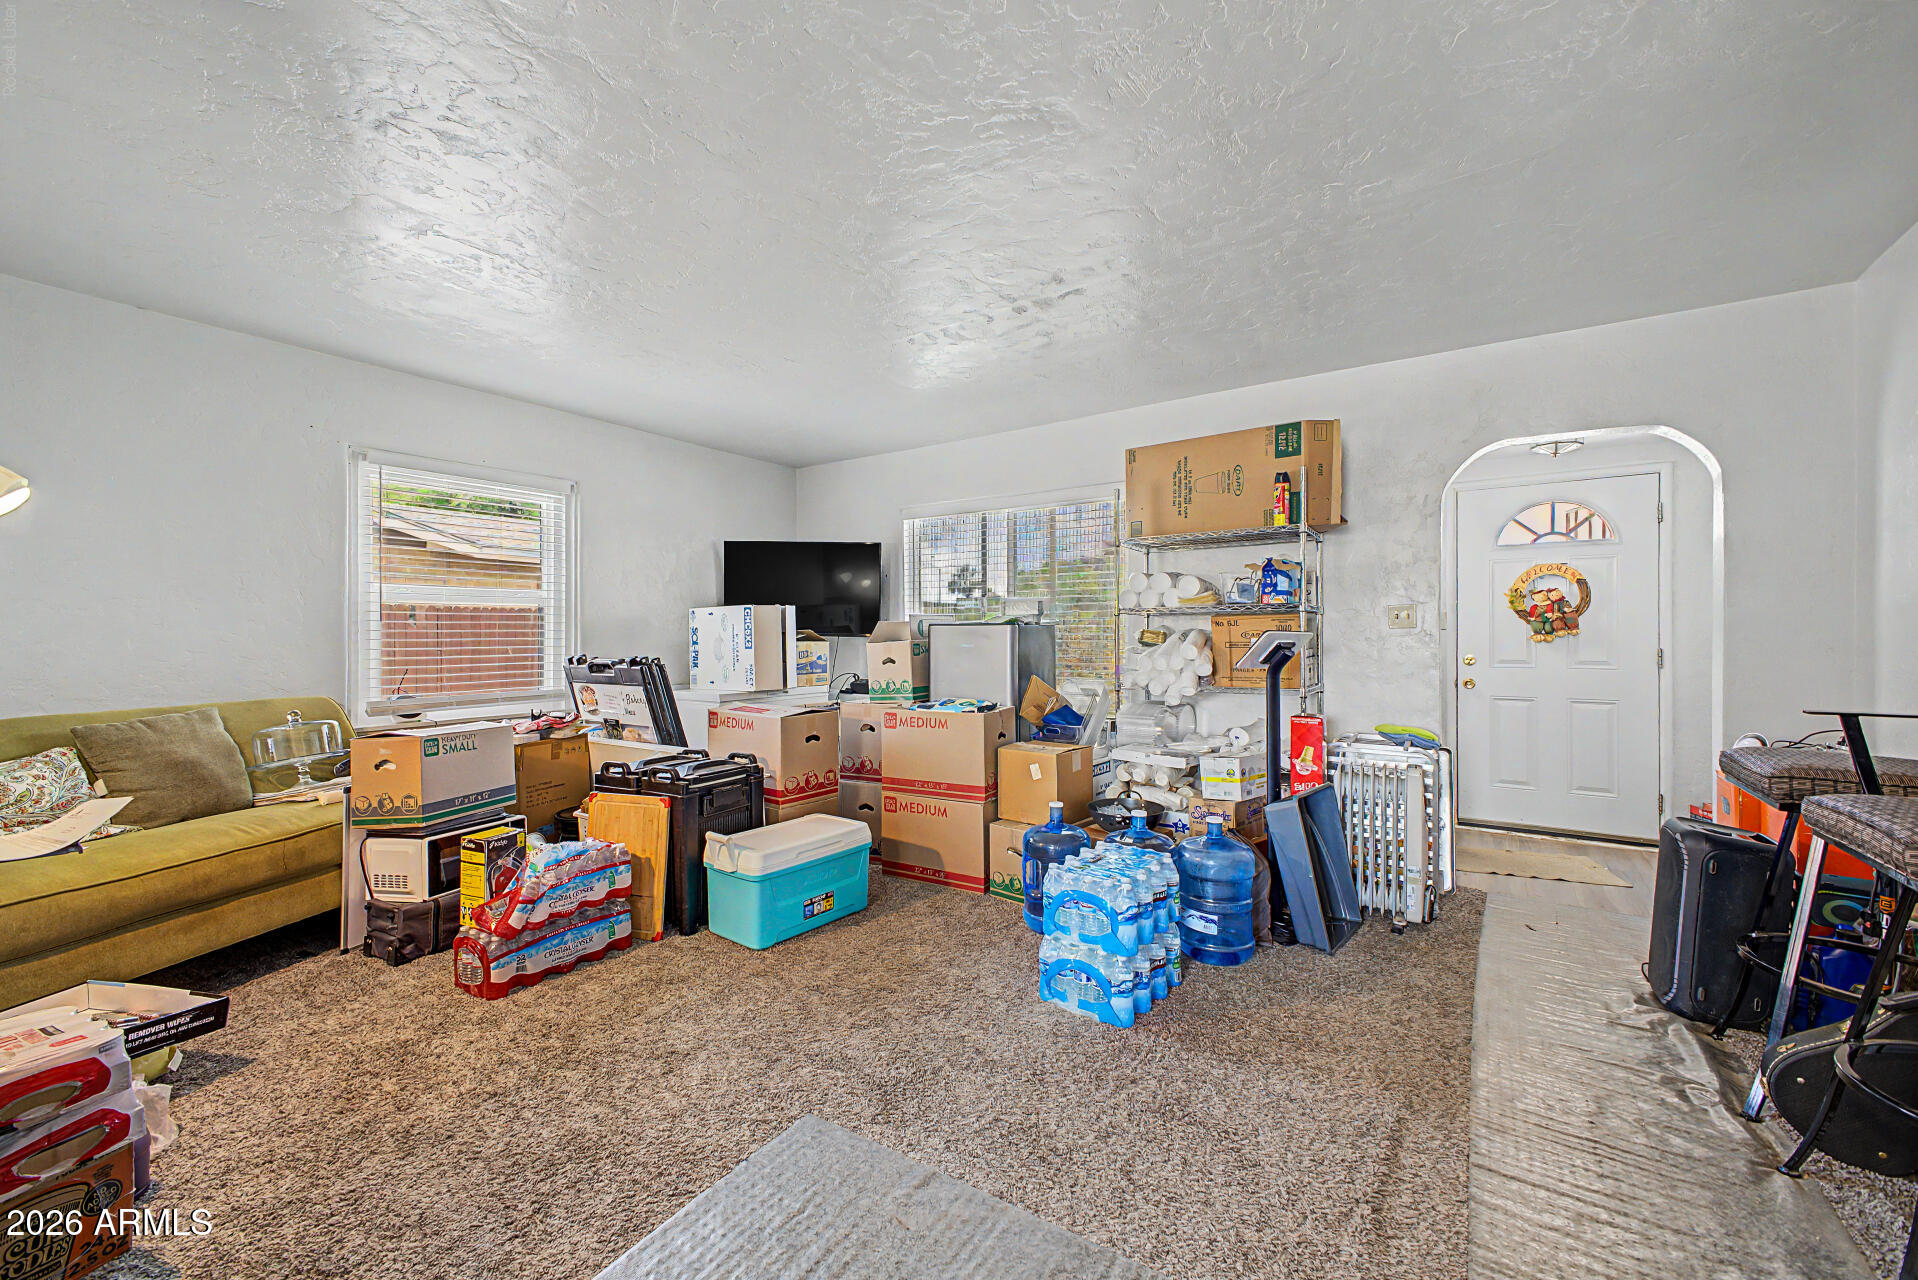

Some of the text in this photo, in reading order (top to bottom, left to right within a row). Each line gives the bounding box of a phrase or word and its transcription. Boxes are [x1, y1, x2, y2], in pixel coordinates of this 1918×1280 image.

[1521, 564, 1568, 584] WELCOME
[718, 716, 754, 731] MEDIUM
[899, 716, 949, 729] MEDIUM
[442, 740, 478, 755] SMALL
[899, 801, 948, 818] MEDIUM
[128, 1024, 165, 1041] REMOVER
